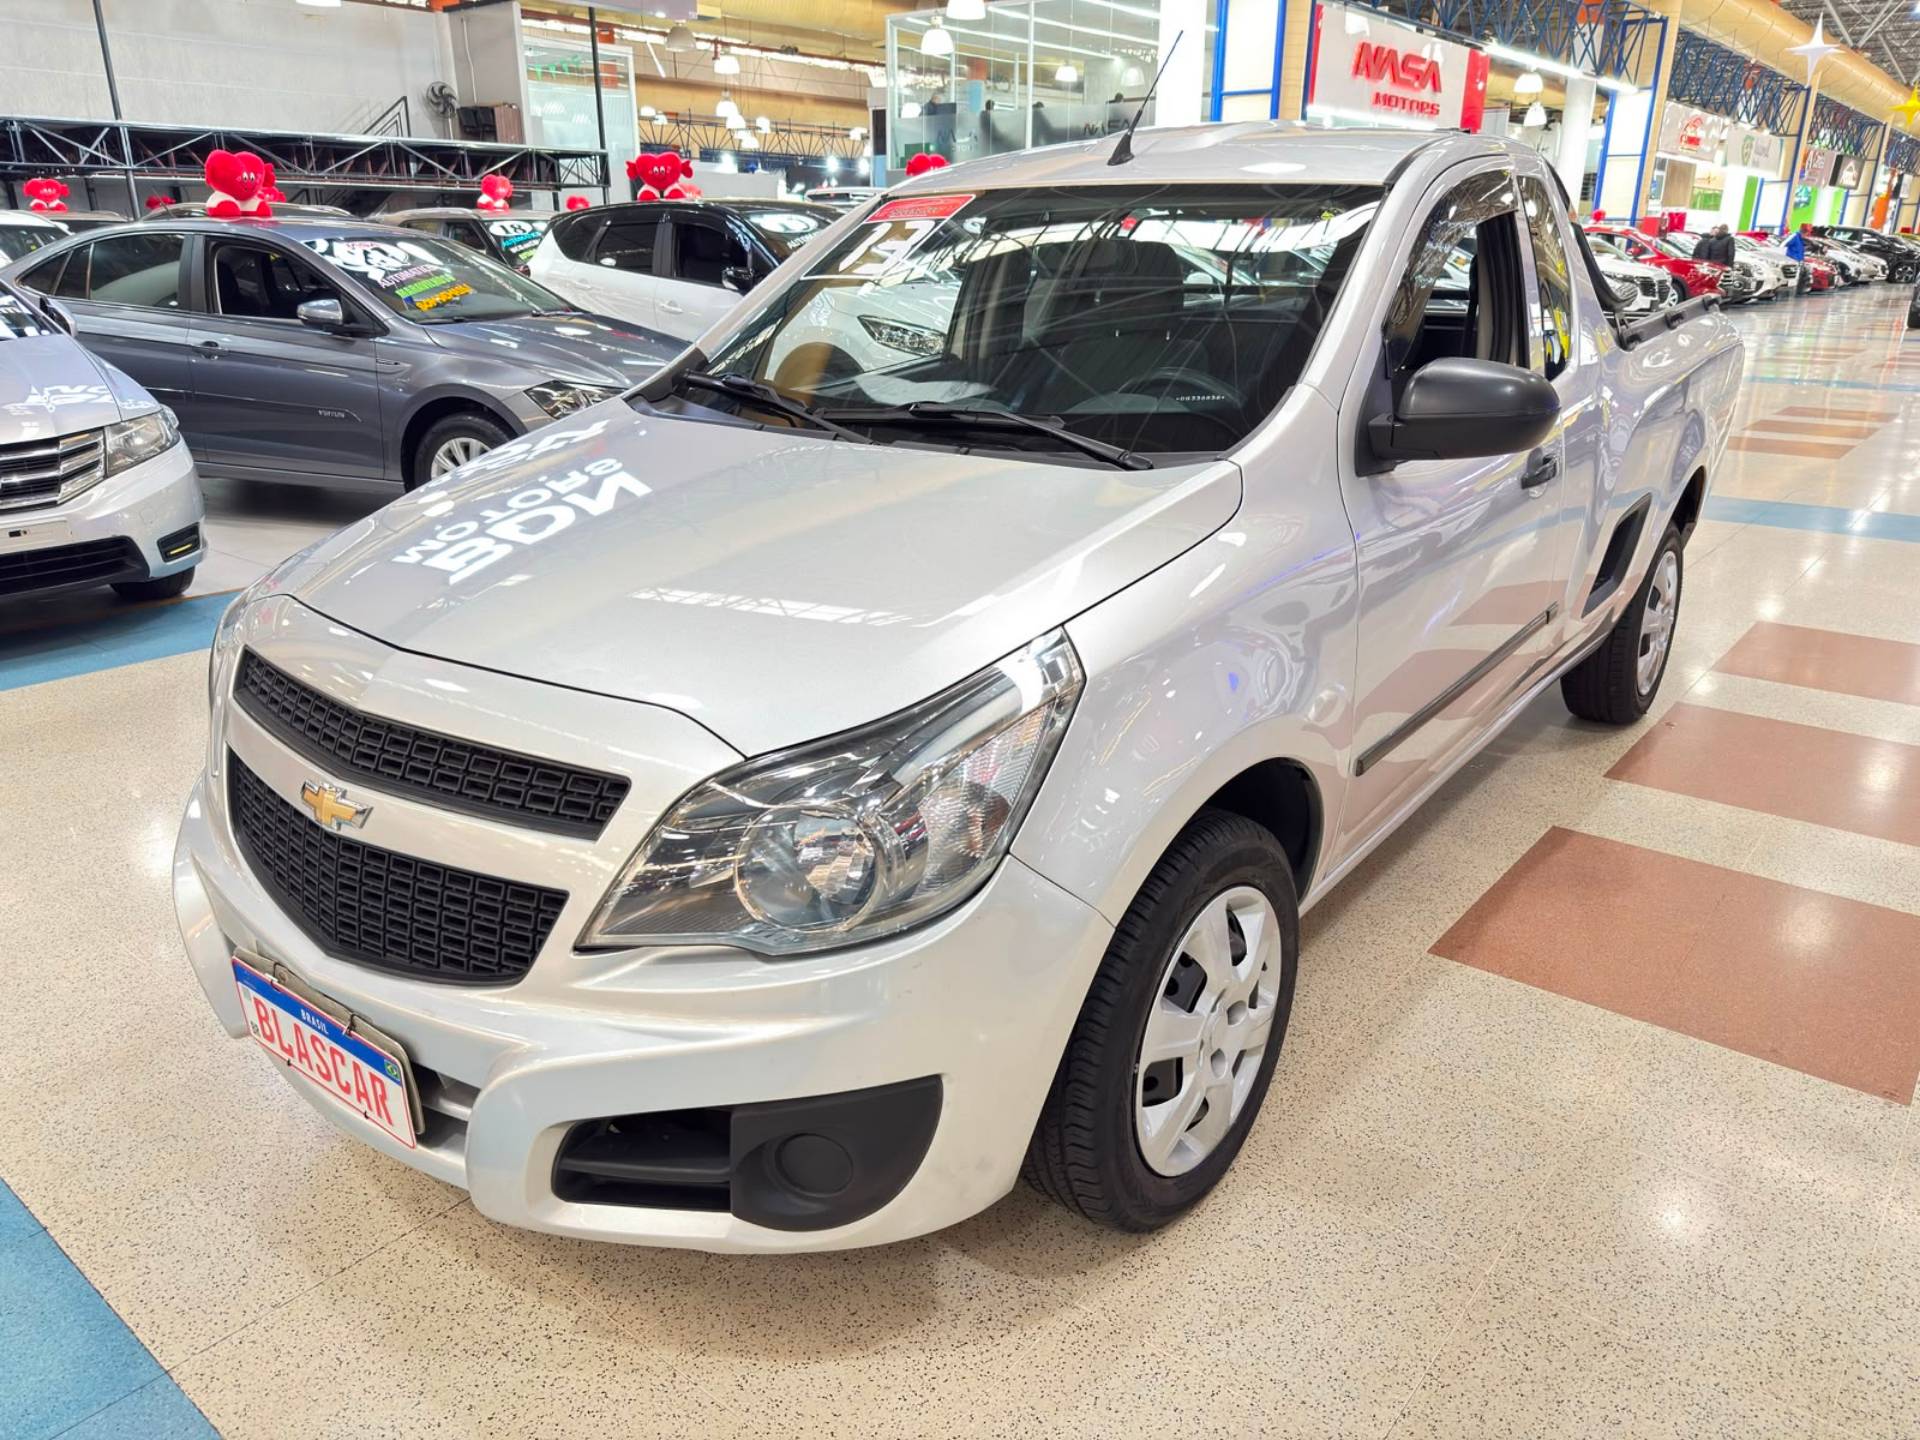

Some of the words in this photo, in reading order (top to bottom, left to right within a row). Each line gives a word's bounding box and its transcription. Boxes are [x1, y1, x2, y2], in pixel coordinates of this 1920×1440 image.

[1354, 41, 1442, 93] NASA
[1373, 91, 1441, 116] MOTORS
[300, 1008, 330, 1035] BRASIL
[253, 996, 394, 1127] BLASCAR
